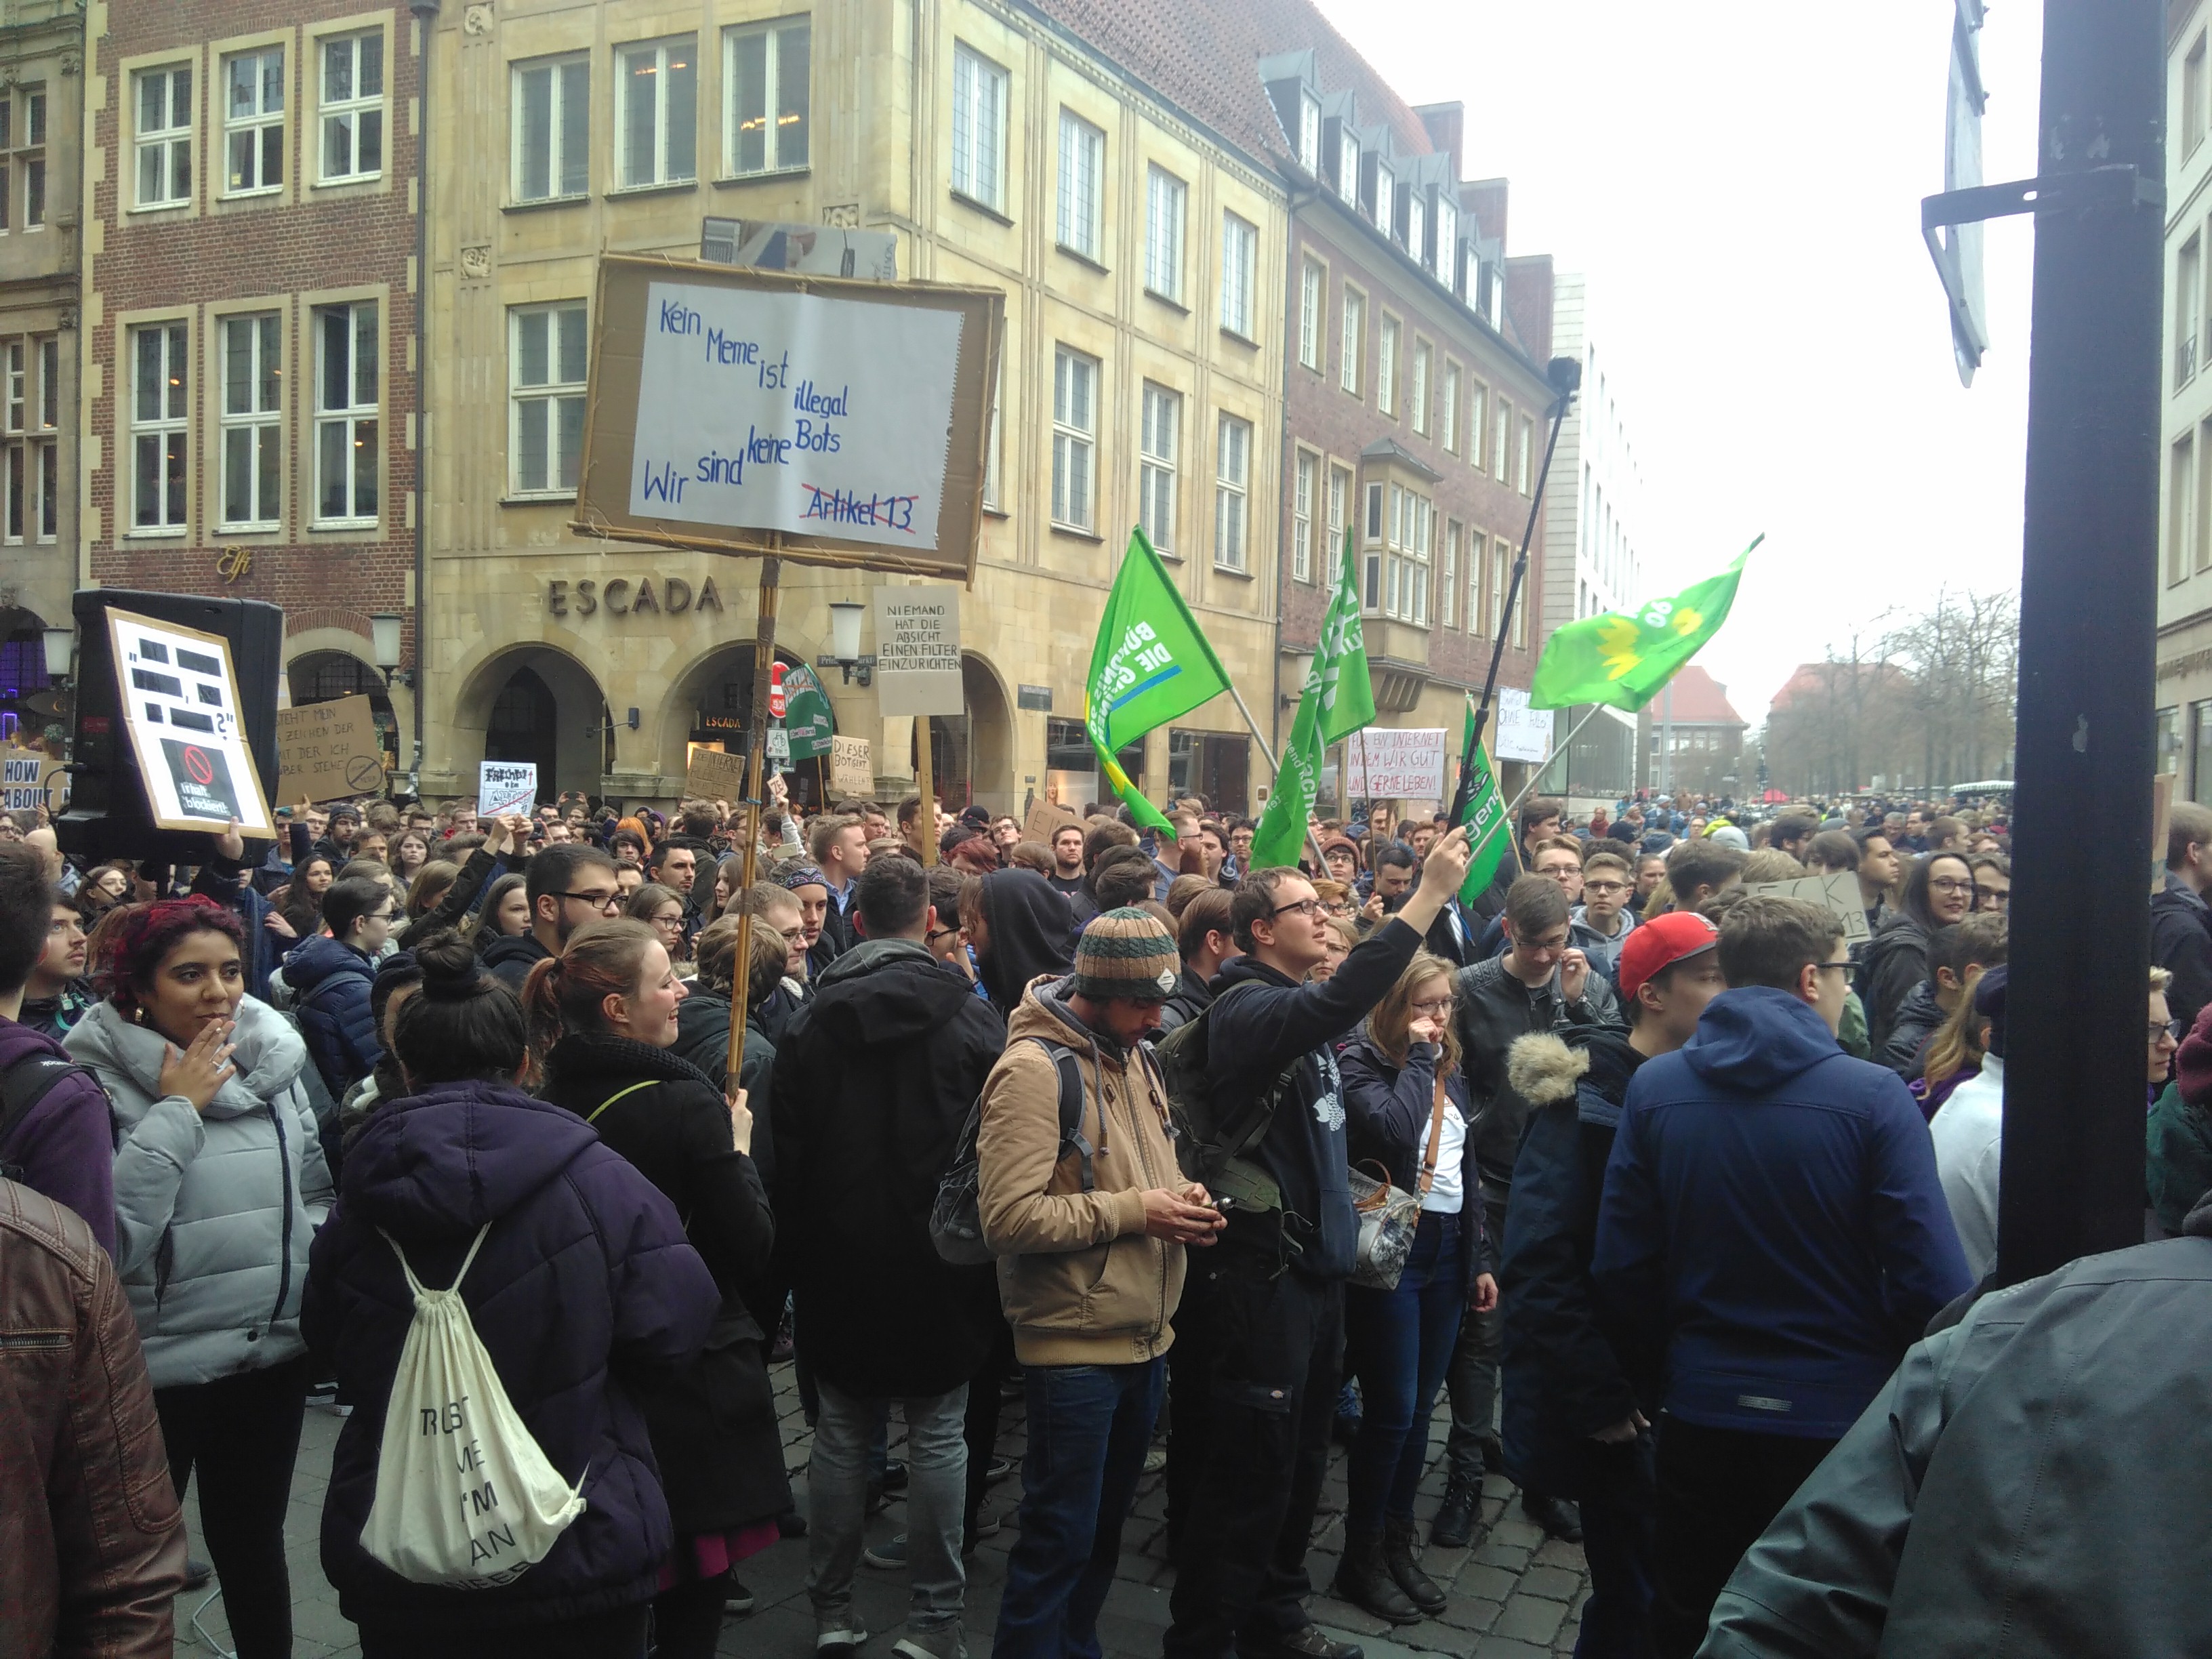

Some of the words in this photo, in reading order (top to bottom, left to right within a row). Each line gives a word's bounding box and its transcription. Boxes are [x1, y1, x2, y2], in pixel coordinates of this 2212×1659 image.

[660, 299, 701, 335] Kein
[706, 327, 759, 365] Meme
[759, 350, 789, 389] ist
[794, 380, 848, 419] illegal
[644, 459, 689, 503] Wir
[696, 449, 744, 485] sind
[746, 424, 792, 464] keine
[796, 419, 841, 452] Bots
[807, 487, 876, 526] Artikel
[883, 496, 913, 529] 13
[549, 575, 724, 614] ESCADA
[887, 605, 945, 615] NIEMAND
[895, 619, 915, 630] HAT
[921, 619, 941, 630] DIE
[897, 632, 941, 643] ABSICHT
[883, 644, 920, 656] EINEN
[922, 644, 957, 656] FILTER
[878, 659, 962, 670] EINZURICHTEN
[334, 722, 354, 734] DER
[705, 716, 741, 729] ESCADA
[1393, 732, 1441, 746] INTERNET
[297, 746, 321, 759] DER
[330, 743, 349, 755] ICH
[834, 739, 869, 760] DIESER
[835, 754, 851, 766] BOT
[1384, 750, 1406, 766] WIR
[1410, 750, 1439, 766] GUT
[4, 760, 39, 782] HOW
[1370, 775, 1401, 792] GERNE
[5, 787, 53, 809] ABOUT
[471, 1523, 516, 1567] AN
